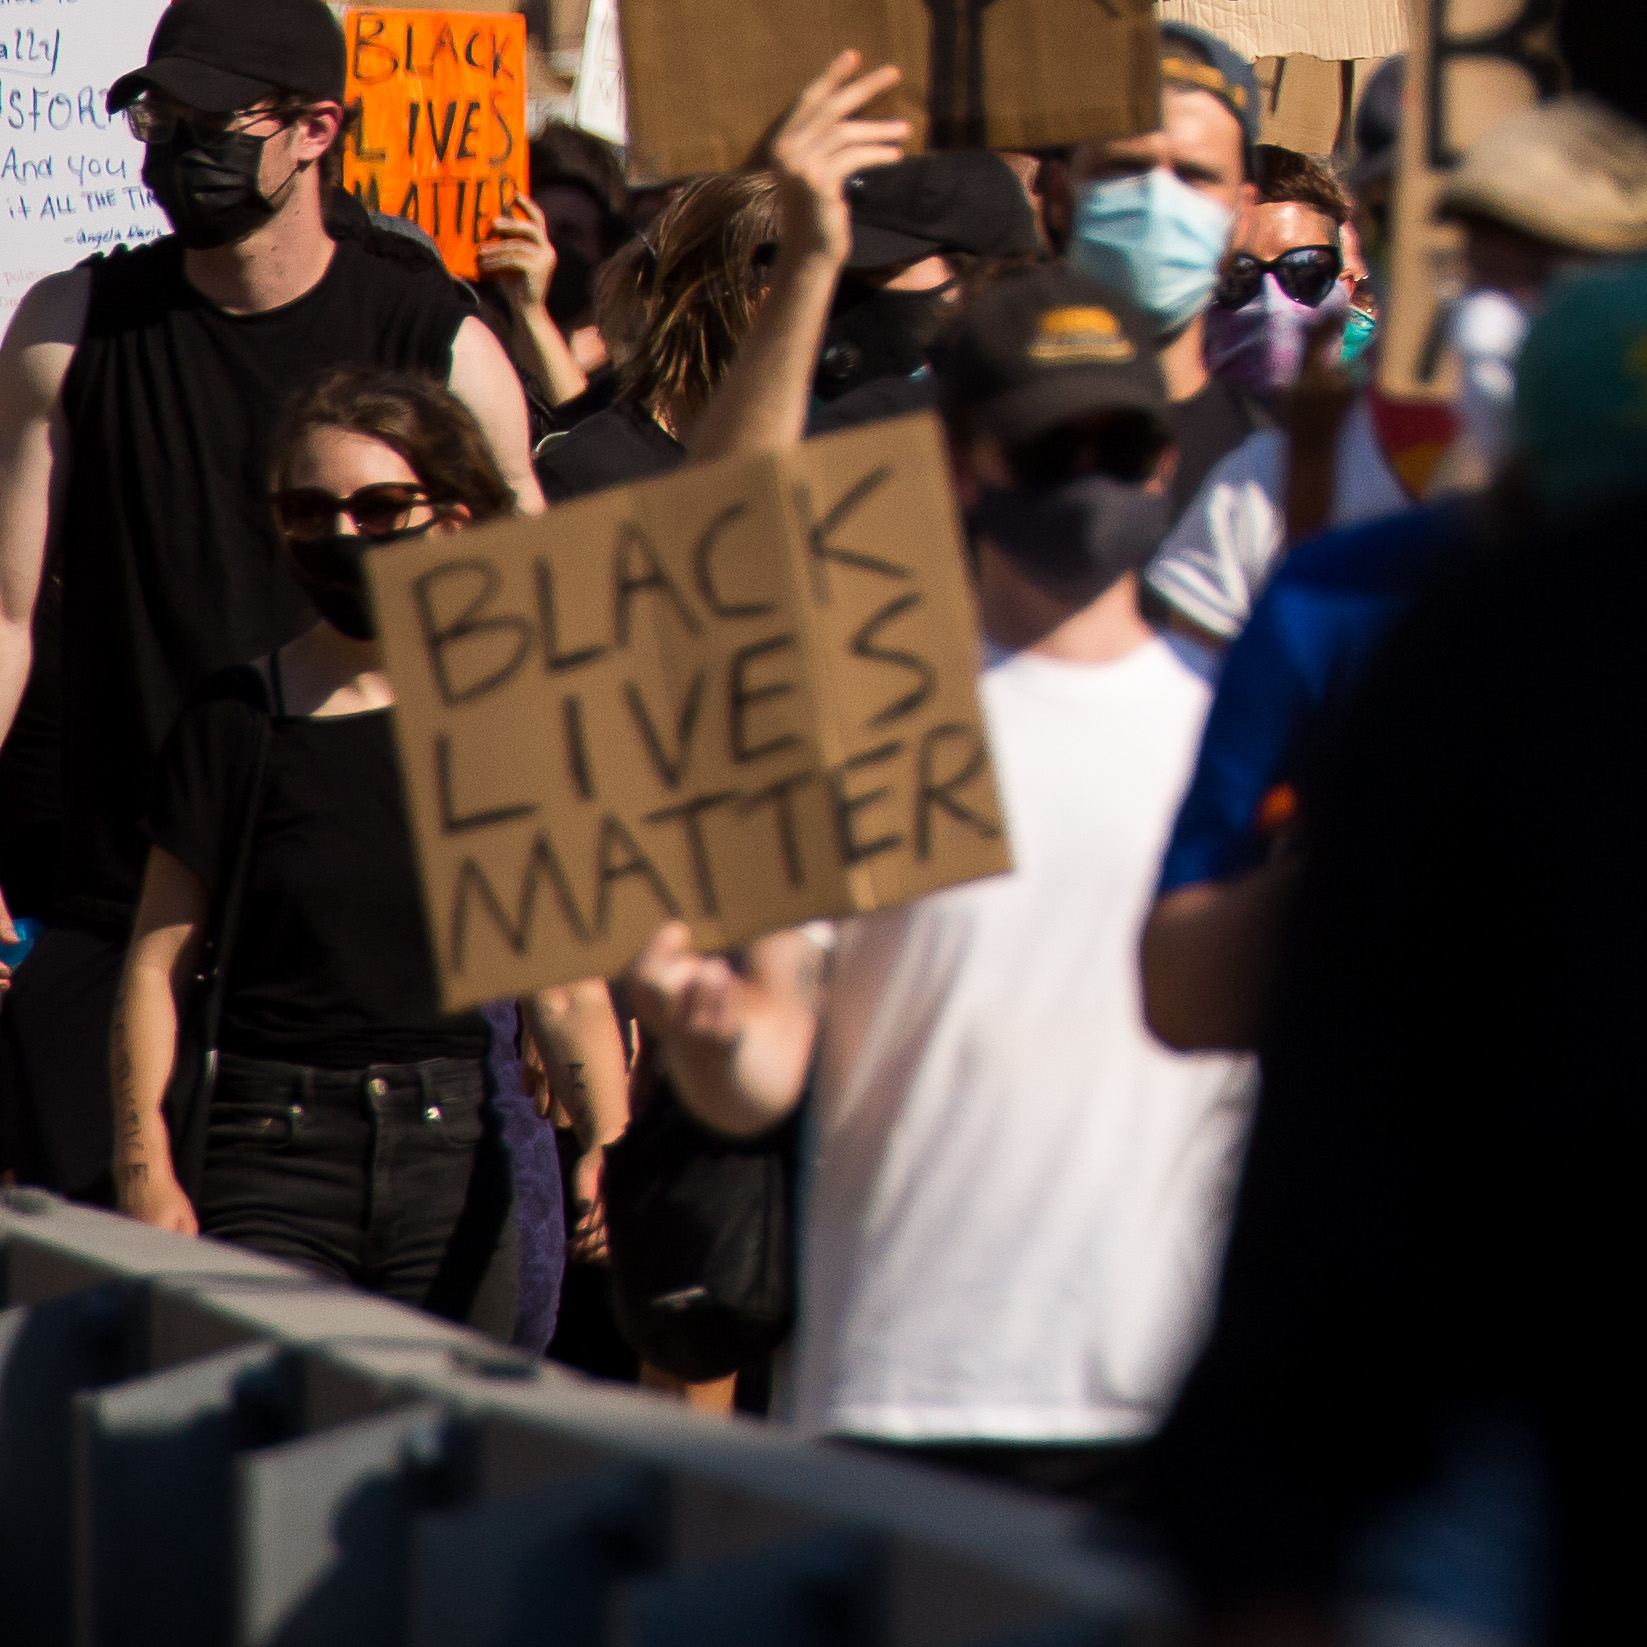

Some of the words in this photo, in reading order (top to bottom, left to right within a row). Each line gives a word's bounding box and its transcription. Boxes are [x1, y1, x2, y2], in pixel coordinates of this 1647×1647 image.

[353, 12, 515, 85] BLACK
[1, 145, 53, 186] And
[68, 154, 126, 186] you
[353, 91, 513, 169] LIVES
[40, 193, 76, 221] ALL
[80, 189, 116, 212] THE
[411, 464, 915, 708] BLACK
[433, 590, 940, 838] LIVES
[448, 721, 1004, 974] MATTER
